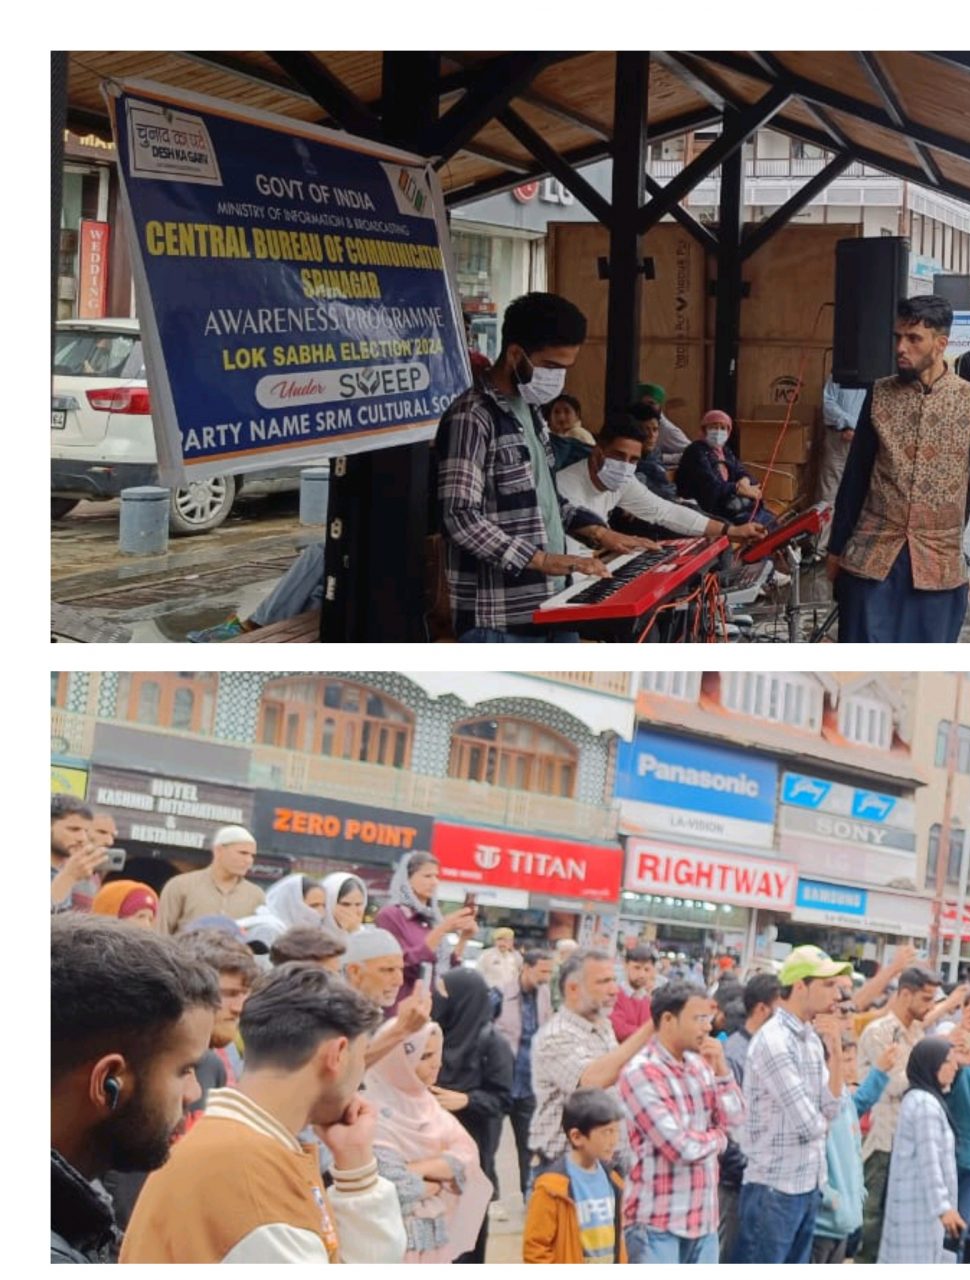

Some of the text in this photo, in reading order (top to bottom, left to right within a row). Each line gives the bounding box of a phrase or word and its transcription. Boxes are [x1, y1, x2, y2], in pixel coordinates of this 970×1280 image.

[256, 174, 376, 211] GOVT OF INDIA
[217, 202, 265, 218] MINISTRY
[268, 206, 282, 220] OF
[283, 208, 344, 228] INFORMATION
[354, 218, 410, 236] BROADCASTING
[145, 220, 250, 259] CENTRAL
[252, 227, 324, 263] BUREAU
[324, 234, 344, 263] OF
[89, 229, 104, 309] WEDDING
[300, 268, 382, 299] SRINAGAR
[204, 305, 445, 336] AWARENESS PROGRAMME
[222, 347, 267, 371] LOK
[273, 343, 336, 366] SABHA
[270, 367, 422, 400] Under SWEEP
[250, 413, 311, 442] NAME
[315, 407, 353, 432] SRM
[357, 397, 430, 426] CULTURAL
[151, 778, 198, 801] HOTEL
[637, 752, 760, 799] Panasonic
[272, 806, 418, 848] ZERO POINT
[669, 813, 725, 835] LA-VISION
[816, 818, 888, 845] SONY
[508, 850, 587, 881] TITAN
[637, 852, 791, 900] RIGHTWAY
